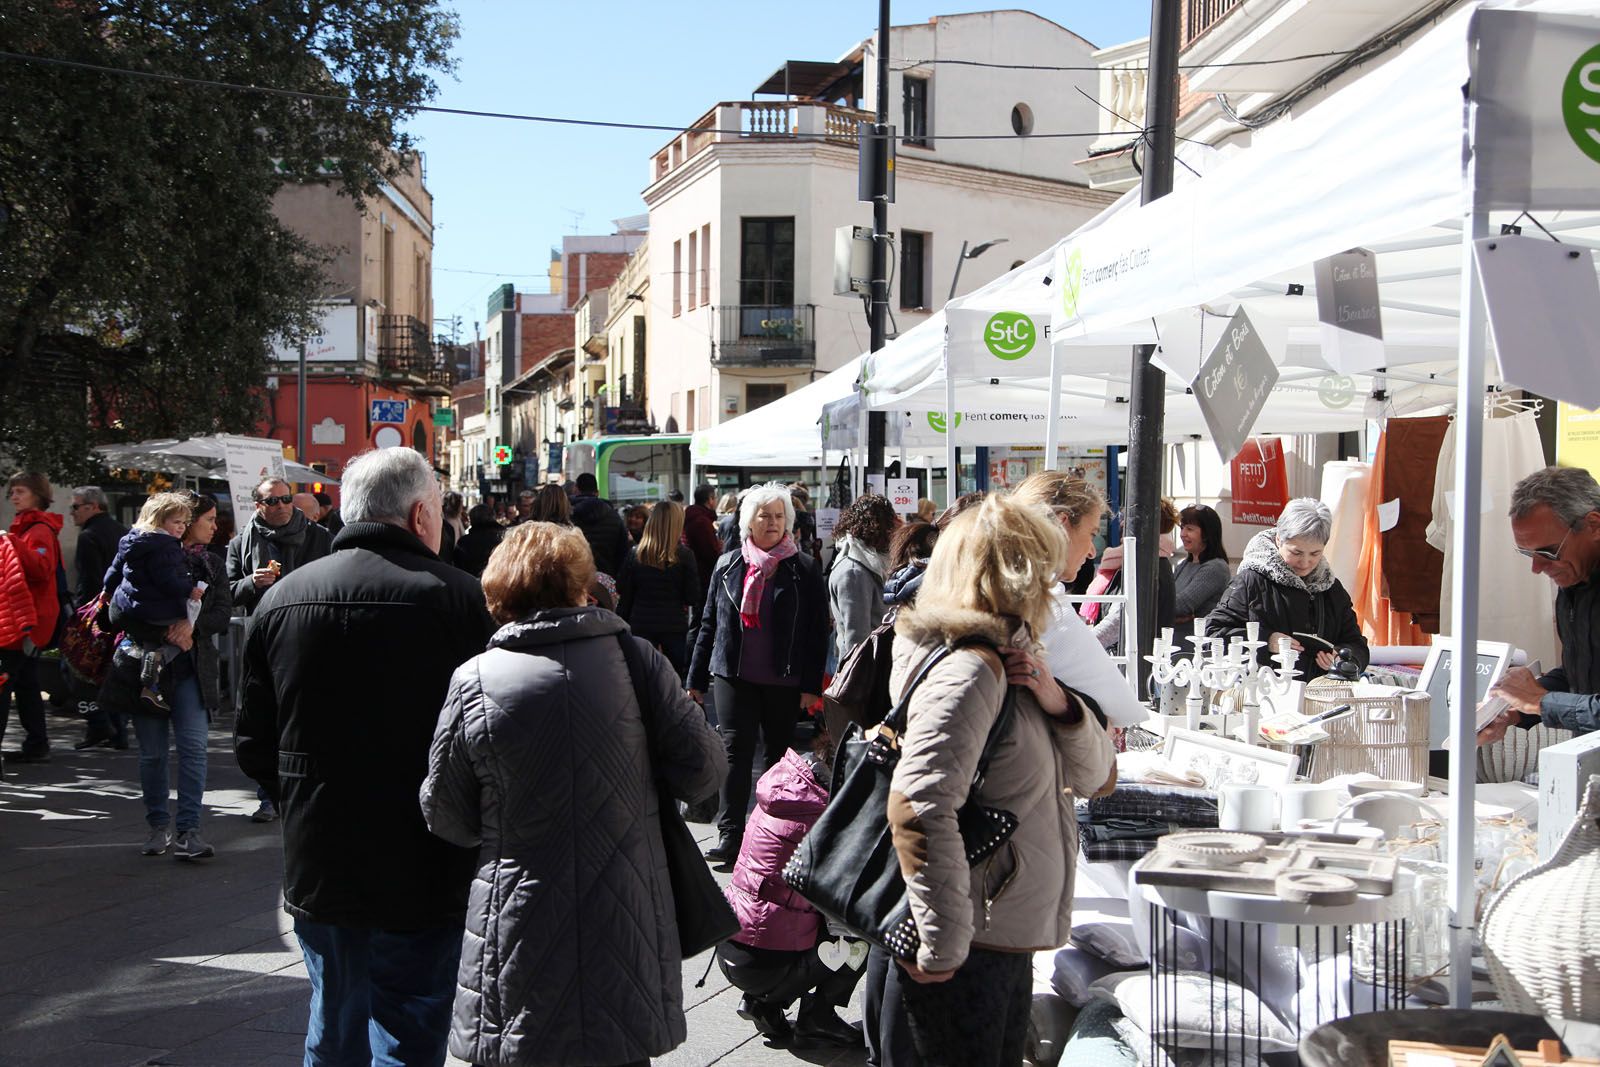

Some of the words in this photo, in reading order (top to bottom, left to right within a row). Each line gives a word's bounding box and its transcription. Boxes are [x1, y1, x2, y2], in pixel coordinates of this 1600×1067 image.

[990, 319, 1029, 344] StC
[1204, 362, 1226, 399] Coton
[1225, 343, 1234, 365] et
[1231, 321, 1250, 351] Bois
[989, 412, 1028, 423] comerç
[1240, 463, 1262, 476] PETIT
